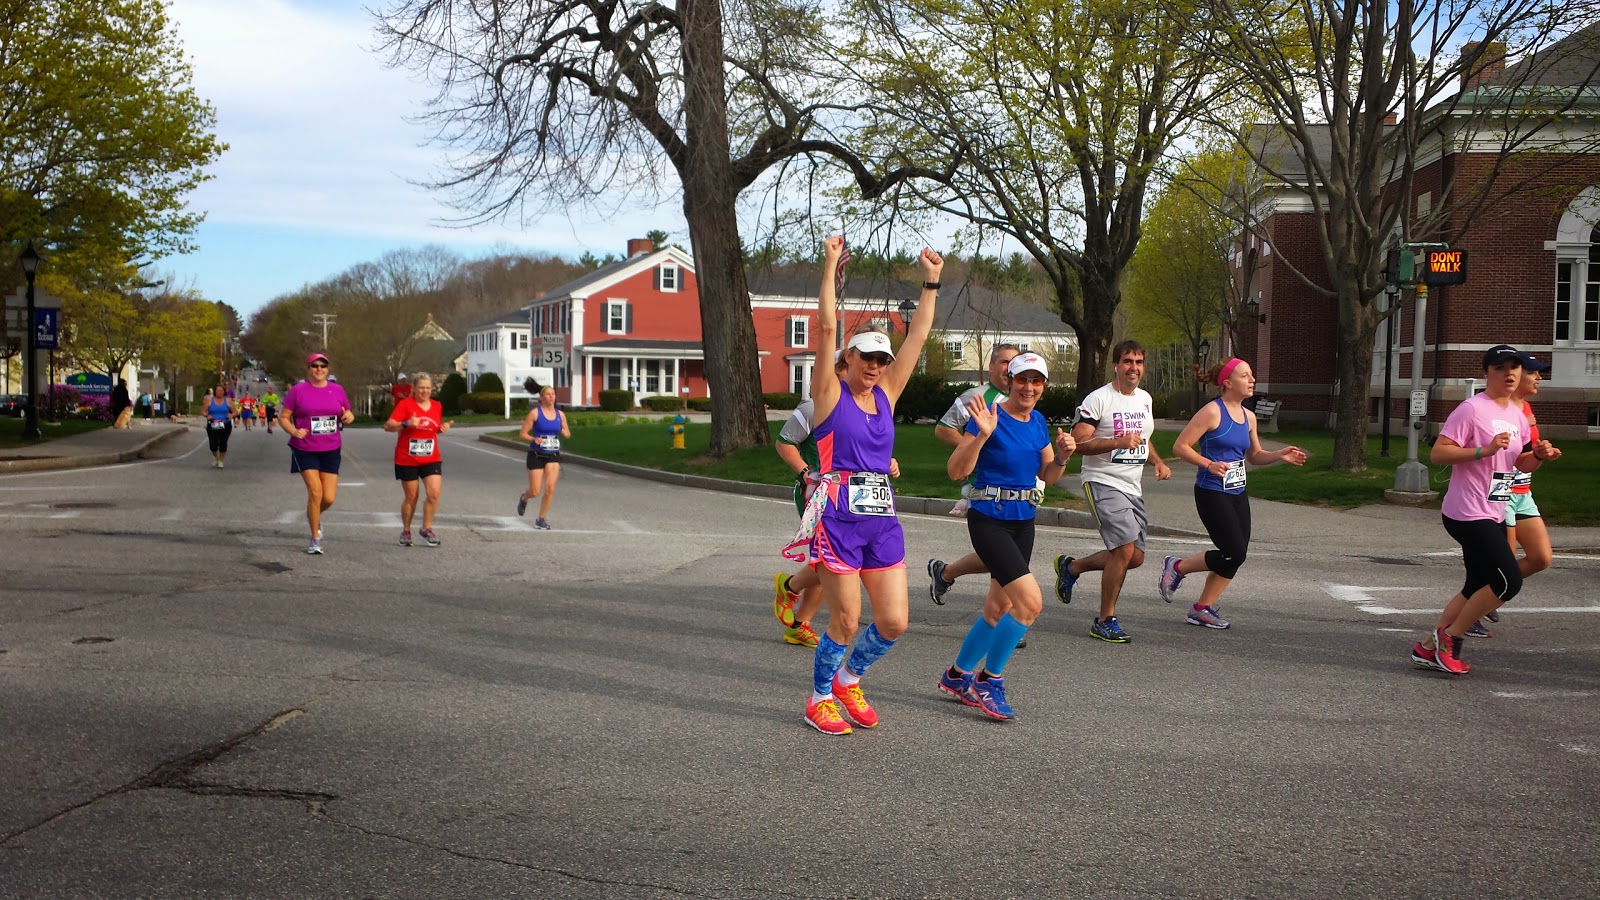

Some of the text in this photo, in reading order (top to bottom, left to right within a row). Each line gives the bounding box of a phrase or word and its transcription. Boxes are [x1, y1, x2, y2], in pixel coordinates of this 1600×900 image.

[1430, 252, 1462, 262] DONT
[1430, 262, 1461, 272] WALK
[543, 335, 564, 343] NORTH
[545, 350, 563, 364] 35
[1124, 412, 1146, 420] SWIM
